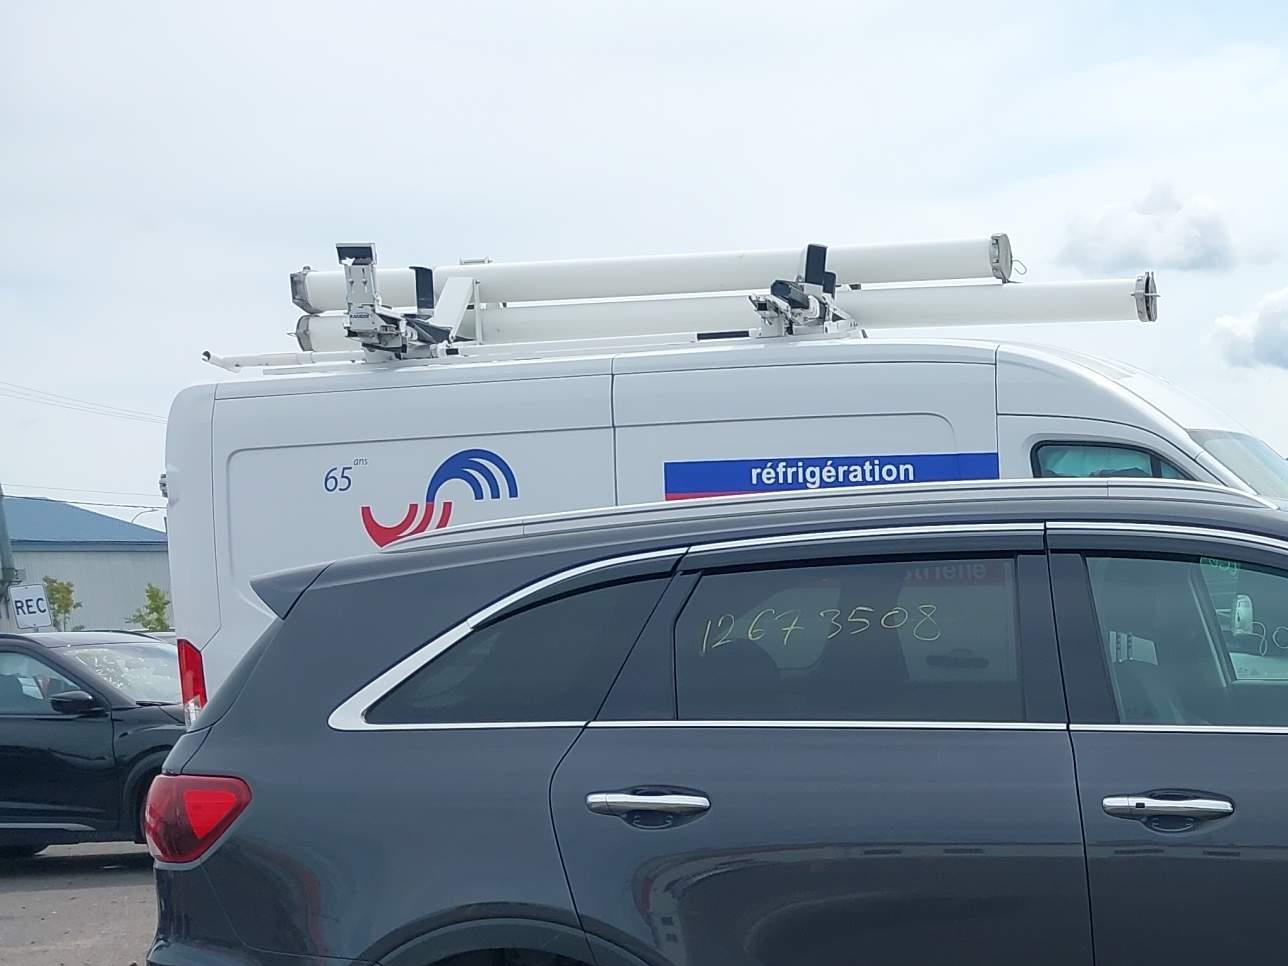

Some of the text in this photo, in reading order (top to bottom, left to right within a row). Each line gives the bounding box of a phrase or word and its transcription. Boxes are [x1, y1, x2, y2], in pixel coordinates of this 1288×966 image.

[324, 458, 369, 492] 65 ans
[751, 459, 914, 489] réfrigération
[14, 597, 47, 615] REC
[700, 604, 941, 656] 12673508
